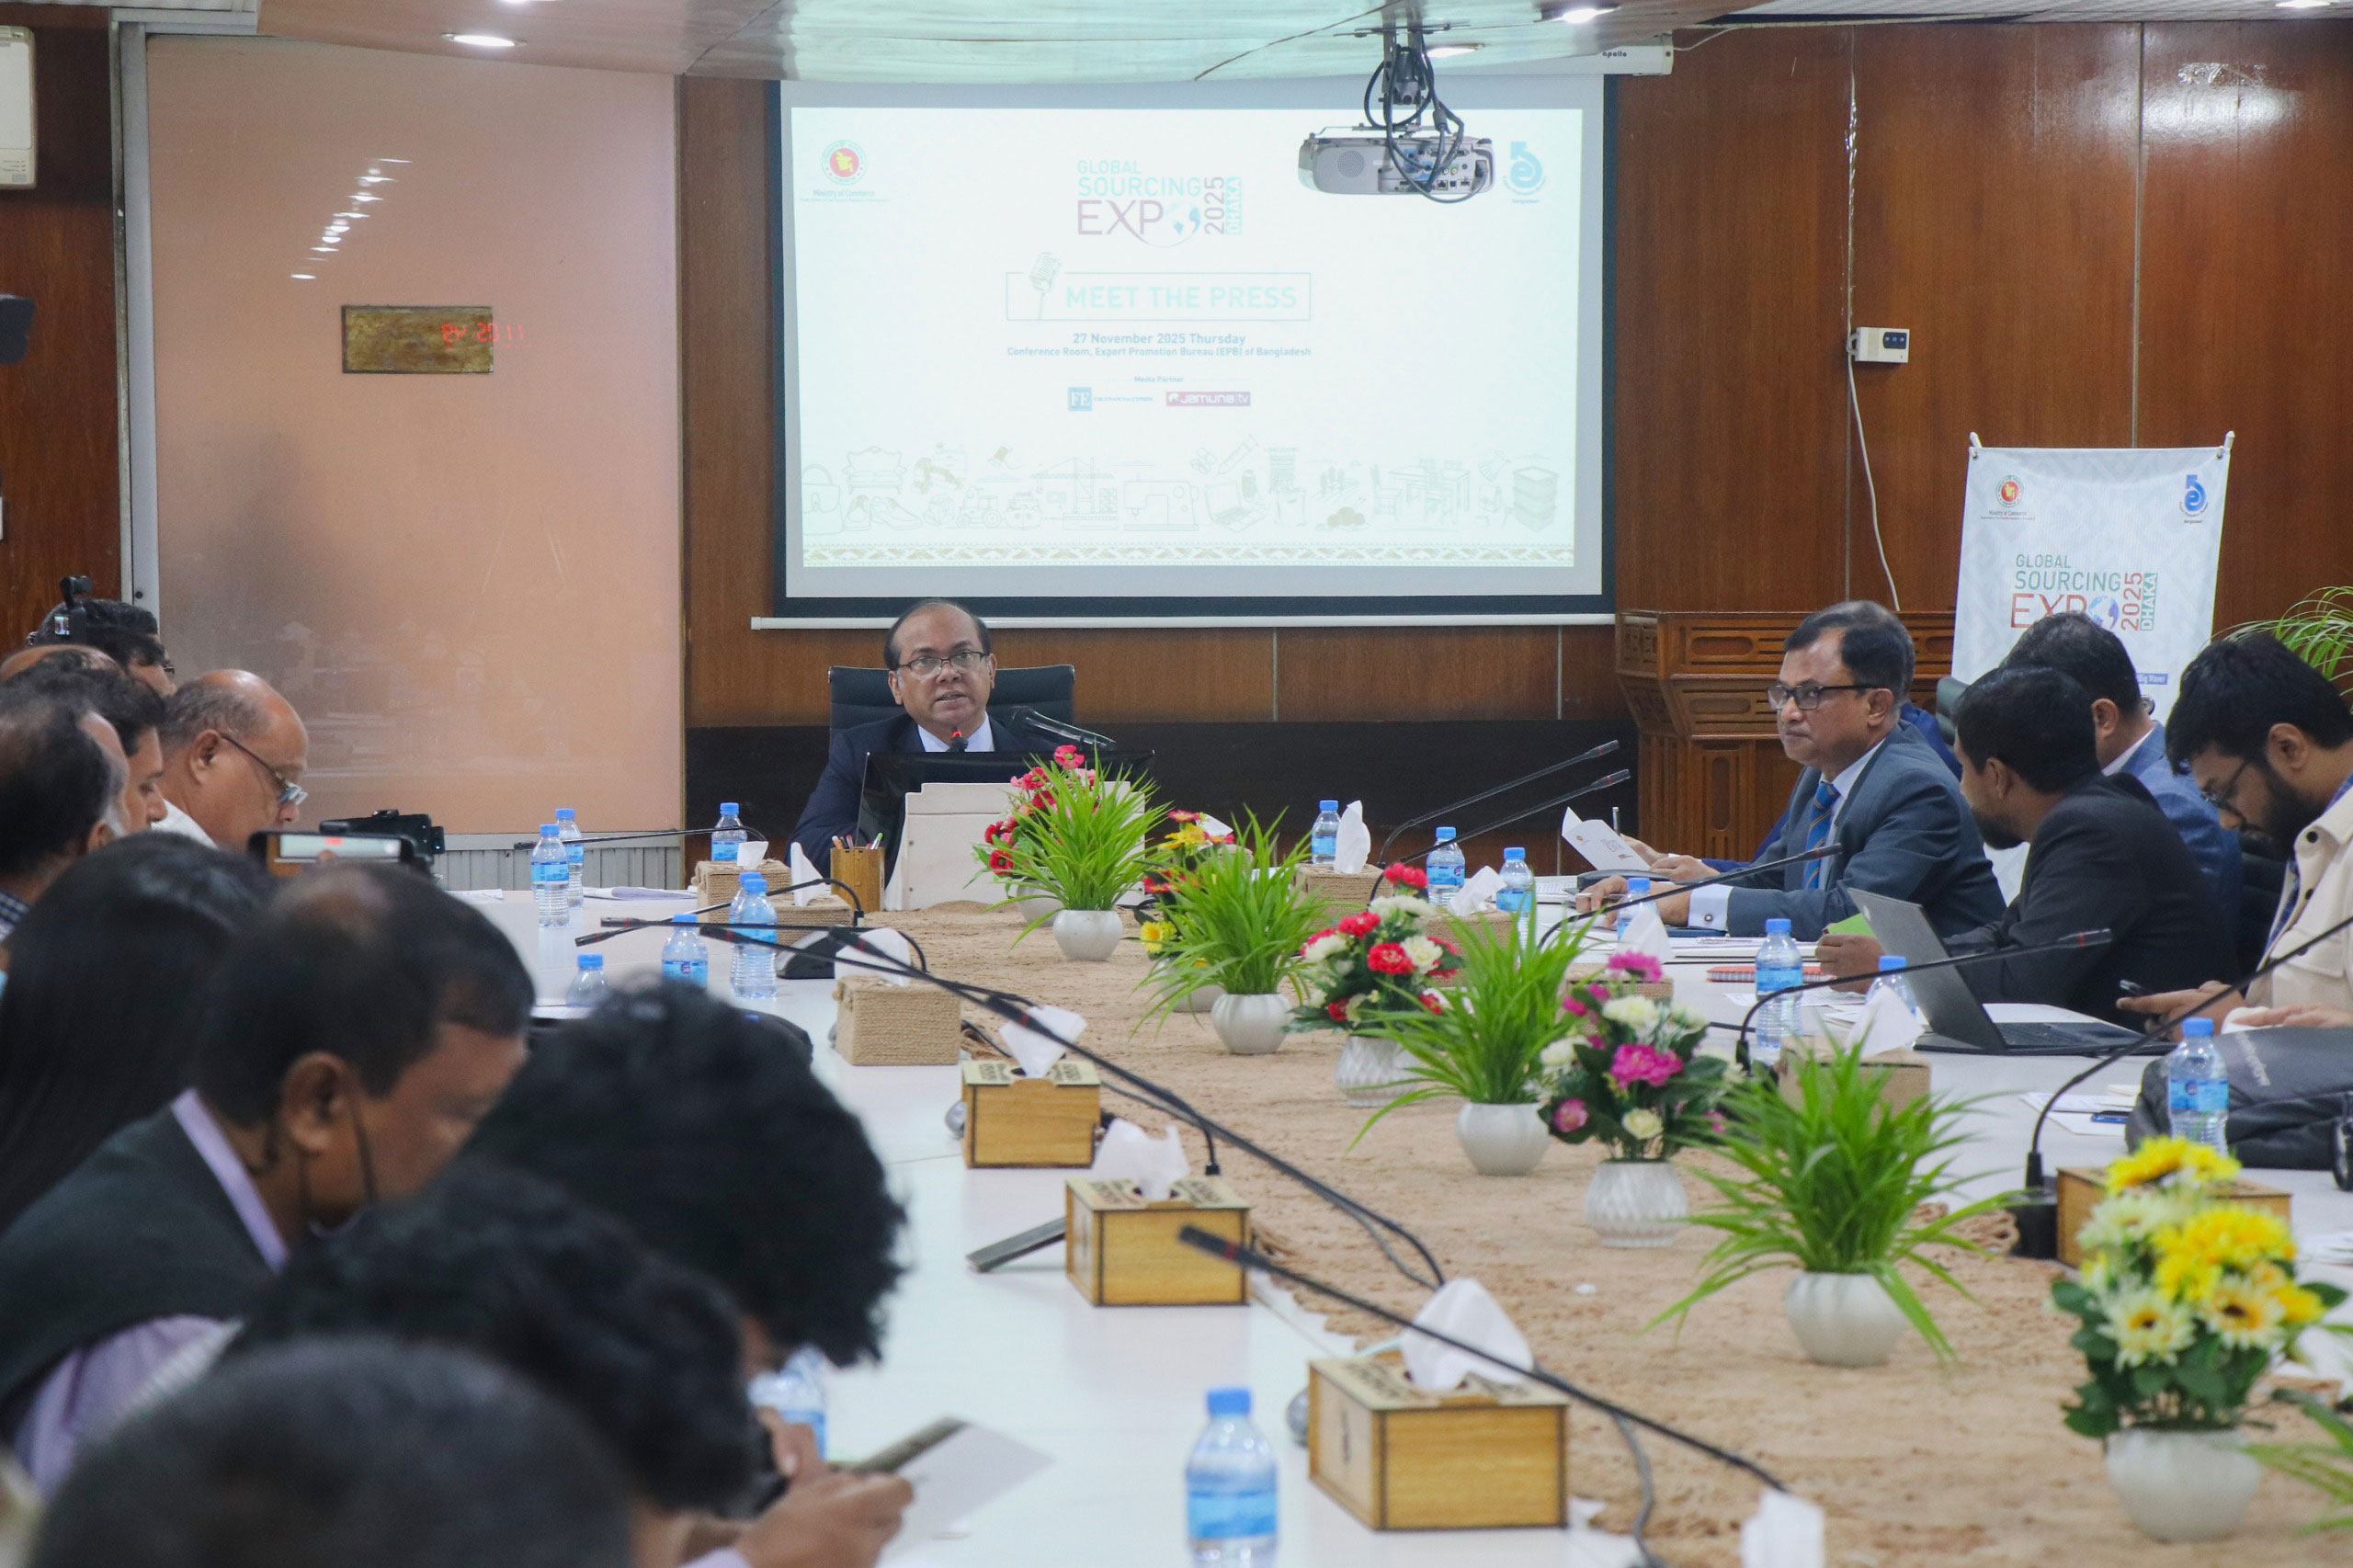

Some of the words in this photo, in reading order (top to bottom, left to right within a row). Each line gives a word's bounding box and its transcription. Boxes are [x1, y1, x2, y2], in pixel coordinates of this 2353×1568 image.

[1077, 160, 1142, 175] GLOBAL
[1078, 176, 1201, 197] SOURCING
[1204, 176, 1224, 234] 2025
[1066, 287, 1139, 308] MEET
[1149, 287, 1200, 308] THE
[1210, 286, 1297, 308] PRESS
[1073, 333, 1089, 345] 27
[1091, 333, 1154, 345] November
[1157, 333, 1186, 345] 2025
[1189, 333, 1246, 347] Thursday
[1006, 347, 1060, 357] Conference
[1063, 347, 1092, 357] Room,
[1095, 347, 1126, 358] Export
[1129, 347, 1177, 357] Promotion
[1180, 347, 1213, 357] Bureau
[1245, 347, 1254, 357] of
[1256, 347, 1312, 358] Bangladesh
[1157, 375, 1185, 383] Partner
[1070, 392, 1090, 406] FE
[2016, 553, 2071, 569] GLOBAL
[2015, 570, 2121, 592] SOURCING
[2120, 572, 2143, 632] 2025
[2140, 573, 2158, 631] DHAKA
